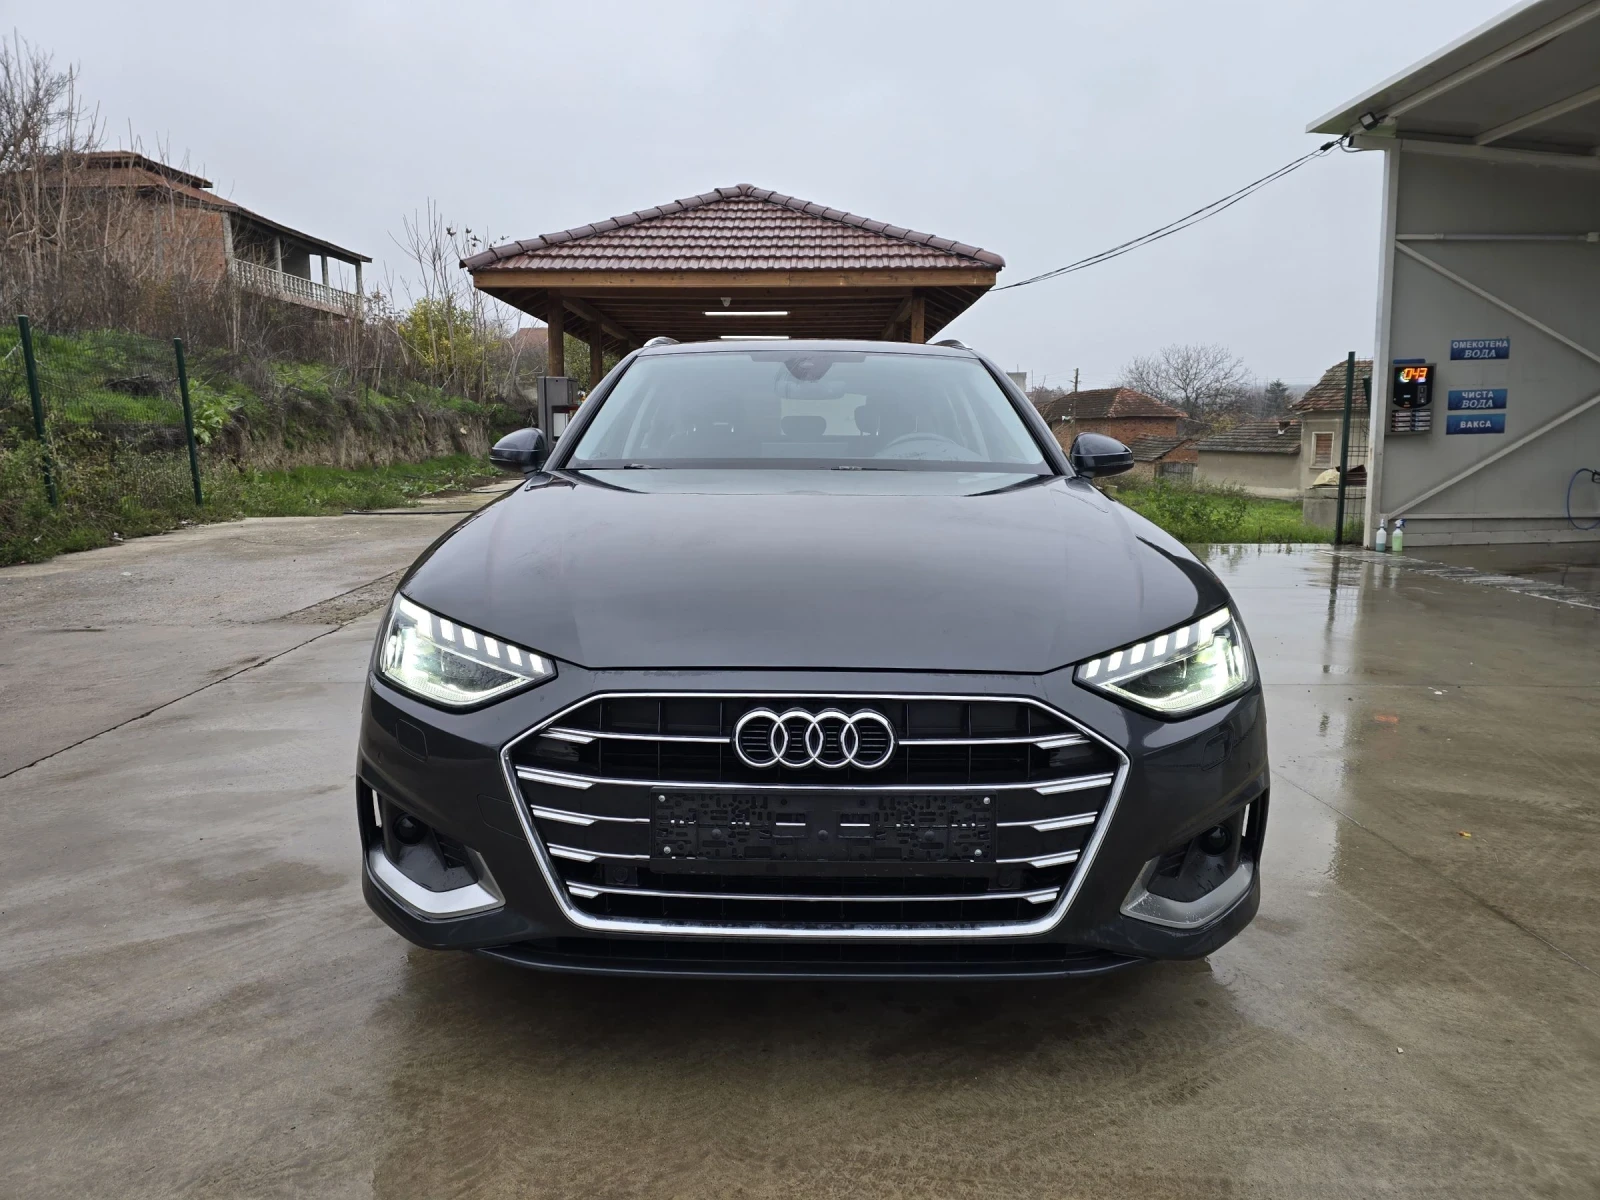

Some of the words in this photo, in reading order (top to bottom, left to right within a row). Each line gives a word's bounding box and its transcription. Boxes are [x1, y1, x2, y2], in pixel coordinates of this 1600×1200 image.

[1452, 340, 1508, 349] ОМЕКОТЕНА
[1463, 349, 1496, 358] ВОДА
[1461, 390, 1494, 398] ЧИСТА
[1461, 399, 1493, 408] ВОДА
[1460, 420, 1492, 428] ВАКСА
